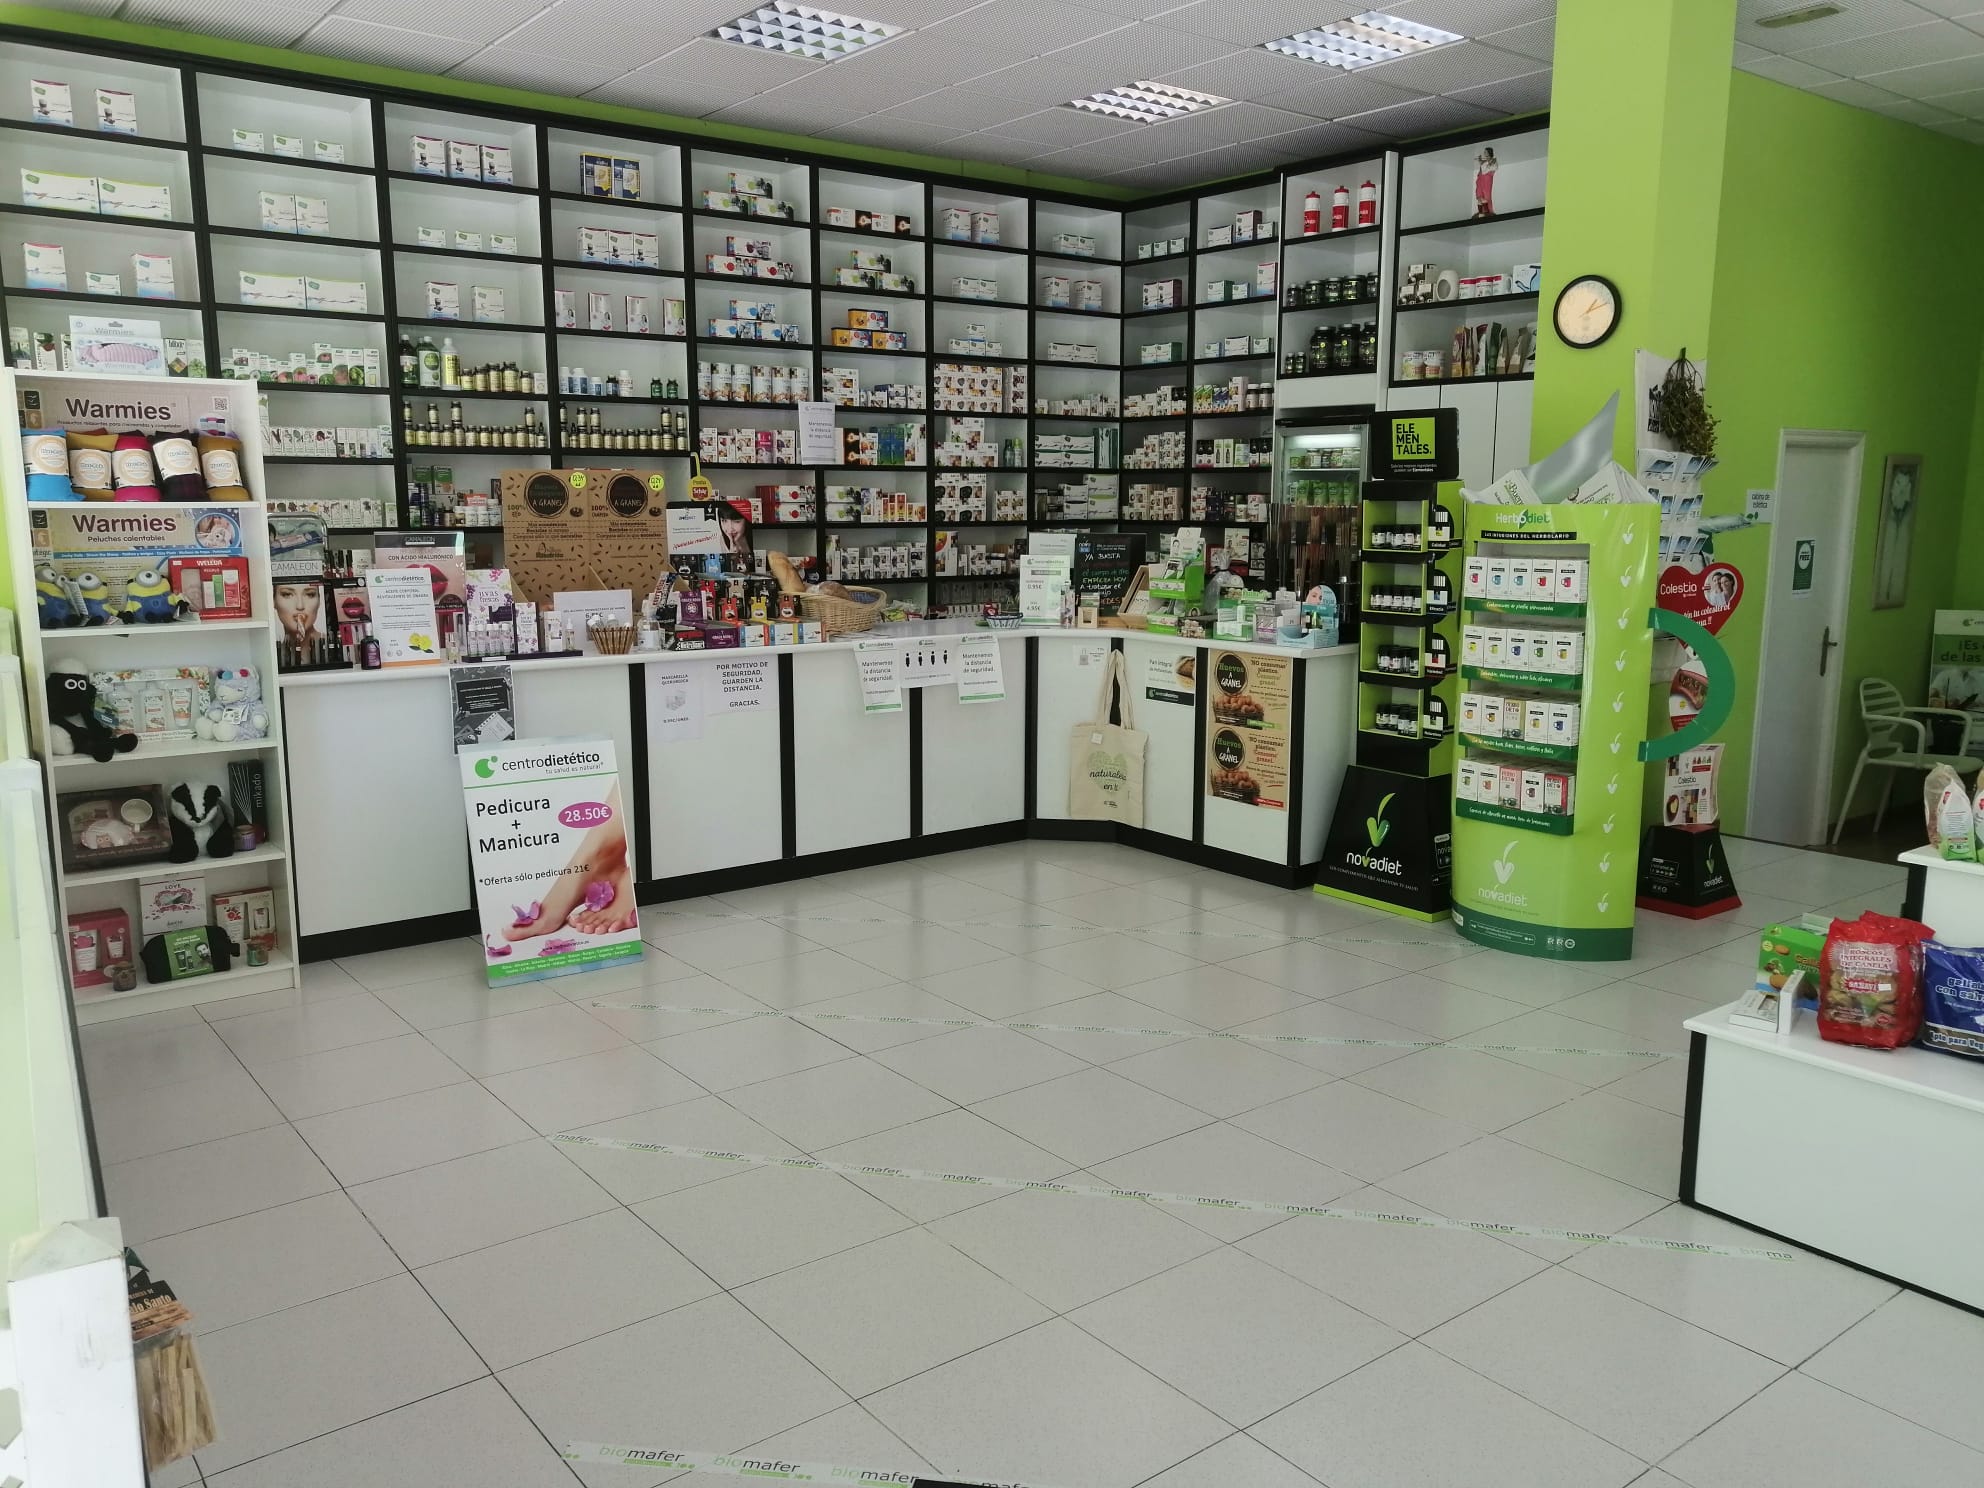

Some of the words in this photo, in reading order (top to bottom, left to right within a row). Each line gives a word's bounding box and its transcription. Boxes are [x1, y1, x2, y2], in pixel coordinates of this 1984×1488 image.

[66, 398, 171, 420] Warmies
[1396, 423, 1415, 434] ELE
[1397, 434, 1420, 444] MEN
[1396, 444, 1432, 454] TALES.
[538, 499, 562, 507] GRANEL
[72, 514, 176, 533] Warmies
[1496, 510, 1550, 526] Herbodiet
[1660, 582, 1697, 595] Colestio
[1941, 652, 1957, 662] de
[1962, 652, 1981, 662] las
[1218, 663, 1244, 672] Huevos
[1221, 678, 1242, 688] GRANEL
[1217, 738, 1241, 749] Huevos
[502, 752, 600, 771] centrodietético
[1219, 753, 1239, 764] GRANEL
[1678, 776, 1696, 785] Colestio
[255, 772, 264, 808] mikado
[476, 796, 550, 816] Pedicura
[565, 806, 610, 823] 28.50€
[479, 831, 560, 853] Manicura
[1346, 848, 1402, 876] novadiet
[515, 869, 533, 882] sólo
[535, 866, 572, 882] pedicura
[574, 864, 590, 874] 21€
[1704, 875, 1724, 888] novadiet
[1478, 886, 1527, 906] novadiet
[1855, 962, 1890, 970] CANELA
[1936, 985, 1957, 996] con
[1948, 1036, 1967, 1047] para
[556, 1132, 593, 1144] mafer
[144, 1294, 172, 1308] Santo
[599, 1445, 685, 1463] biomafer
[714, 1454, 801, 1474] biomafer
